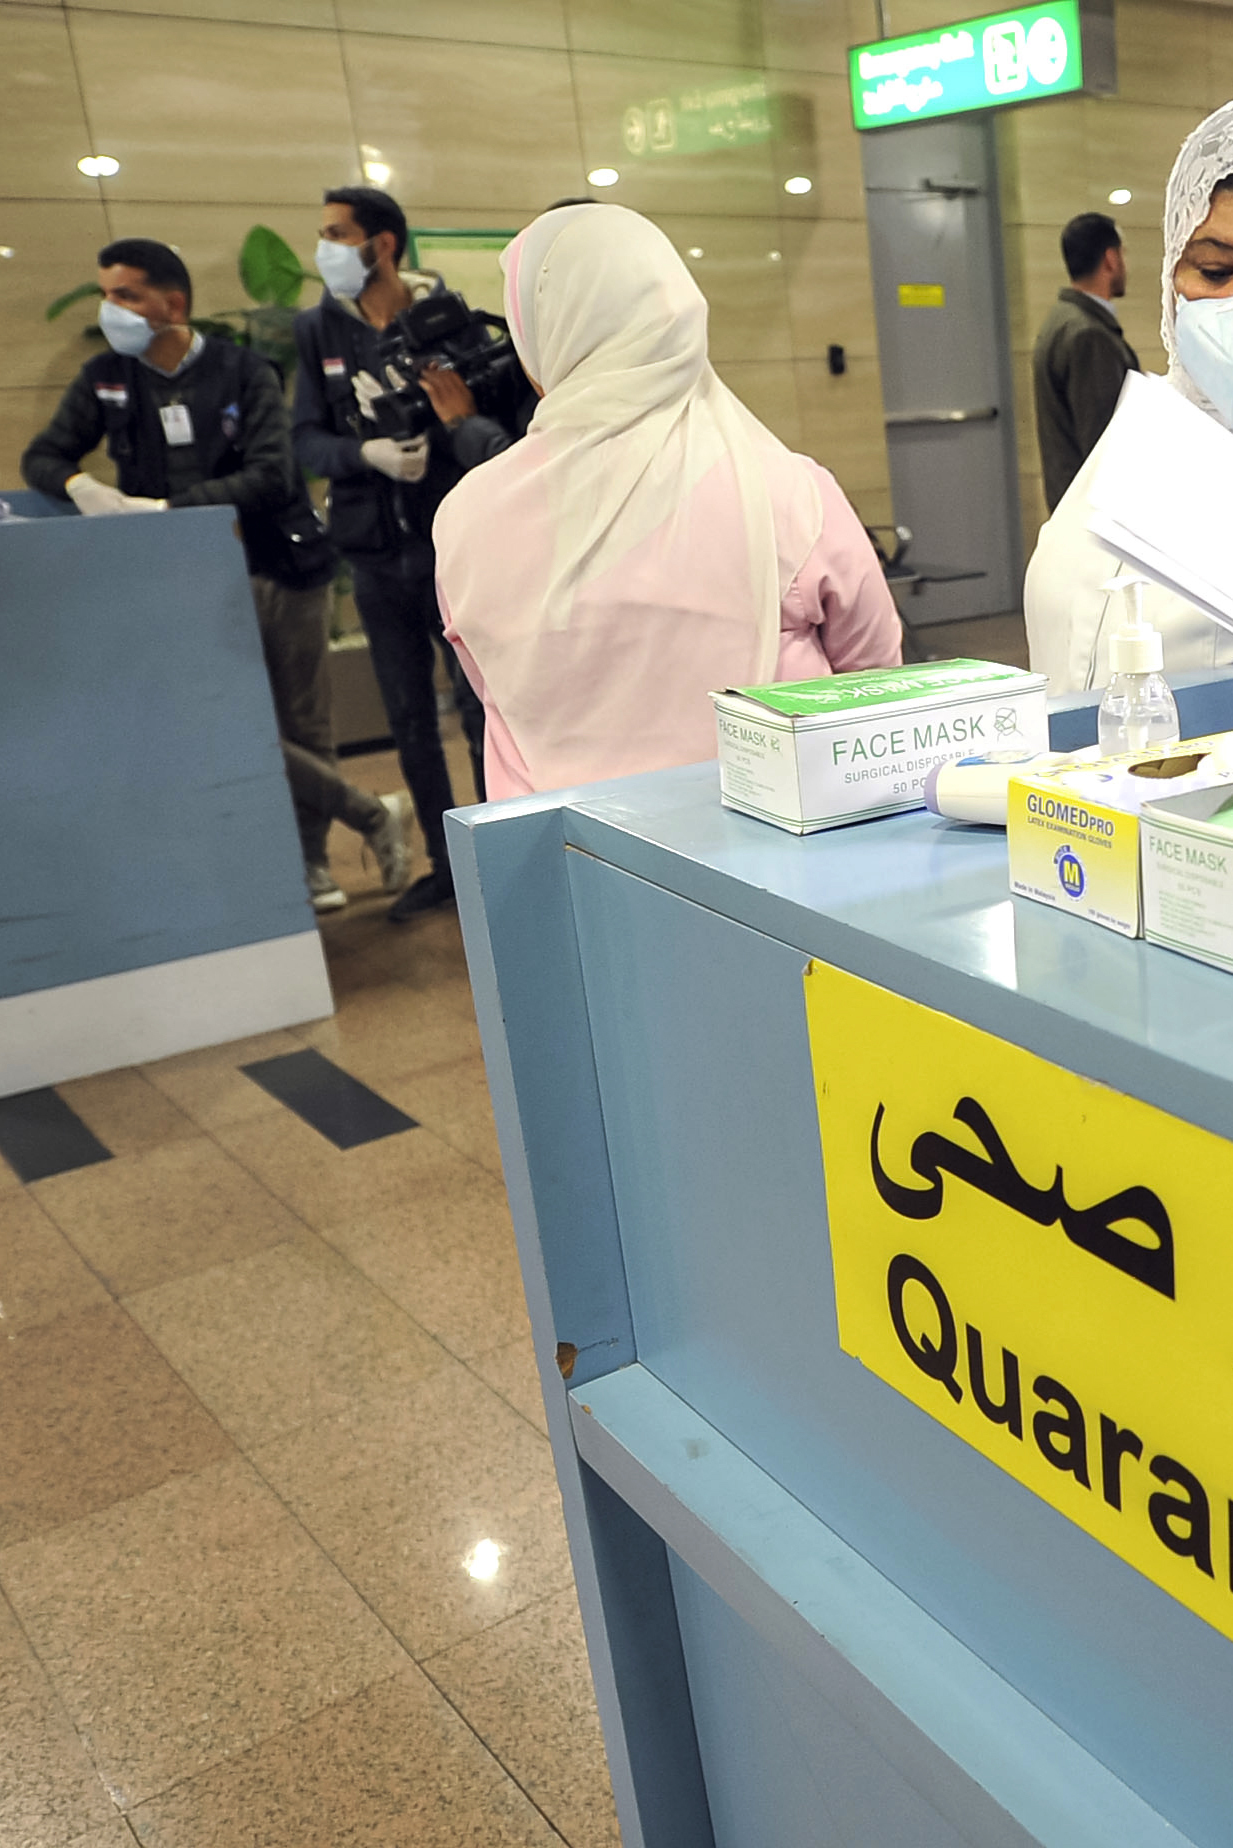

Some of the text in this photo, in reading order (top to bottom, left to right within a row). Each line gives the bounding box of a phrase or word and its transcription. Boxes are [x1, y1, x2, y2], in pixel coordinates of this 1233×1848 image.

[718, 718, 767, 748] FACE MASK
[832, 714, 985, 766] FACE MASK
[844, 762, 904, 784] SURGICAL
[893, 782, 907, 794] 50
[1026, 793, 1115, 837] GLOMEDPRO
[1148, 835, 1183, 862] FACE
[1185, 847, 1228, 875] MASK
[1063, 859, 1081, 888] M
